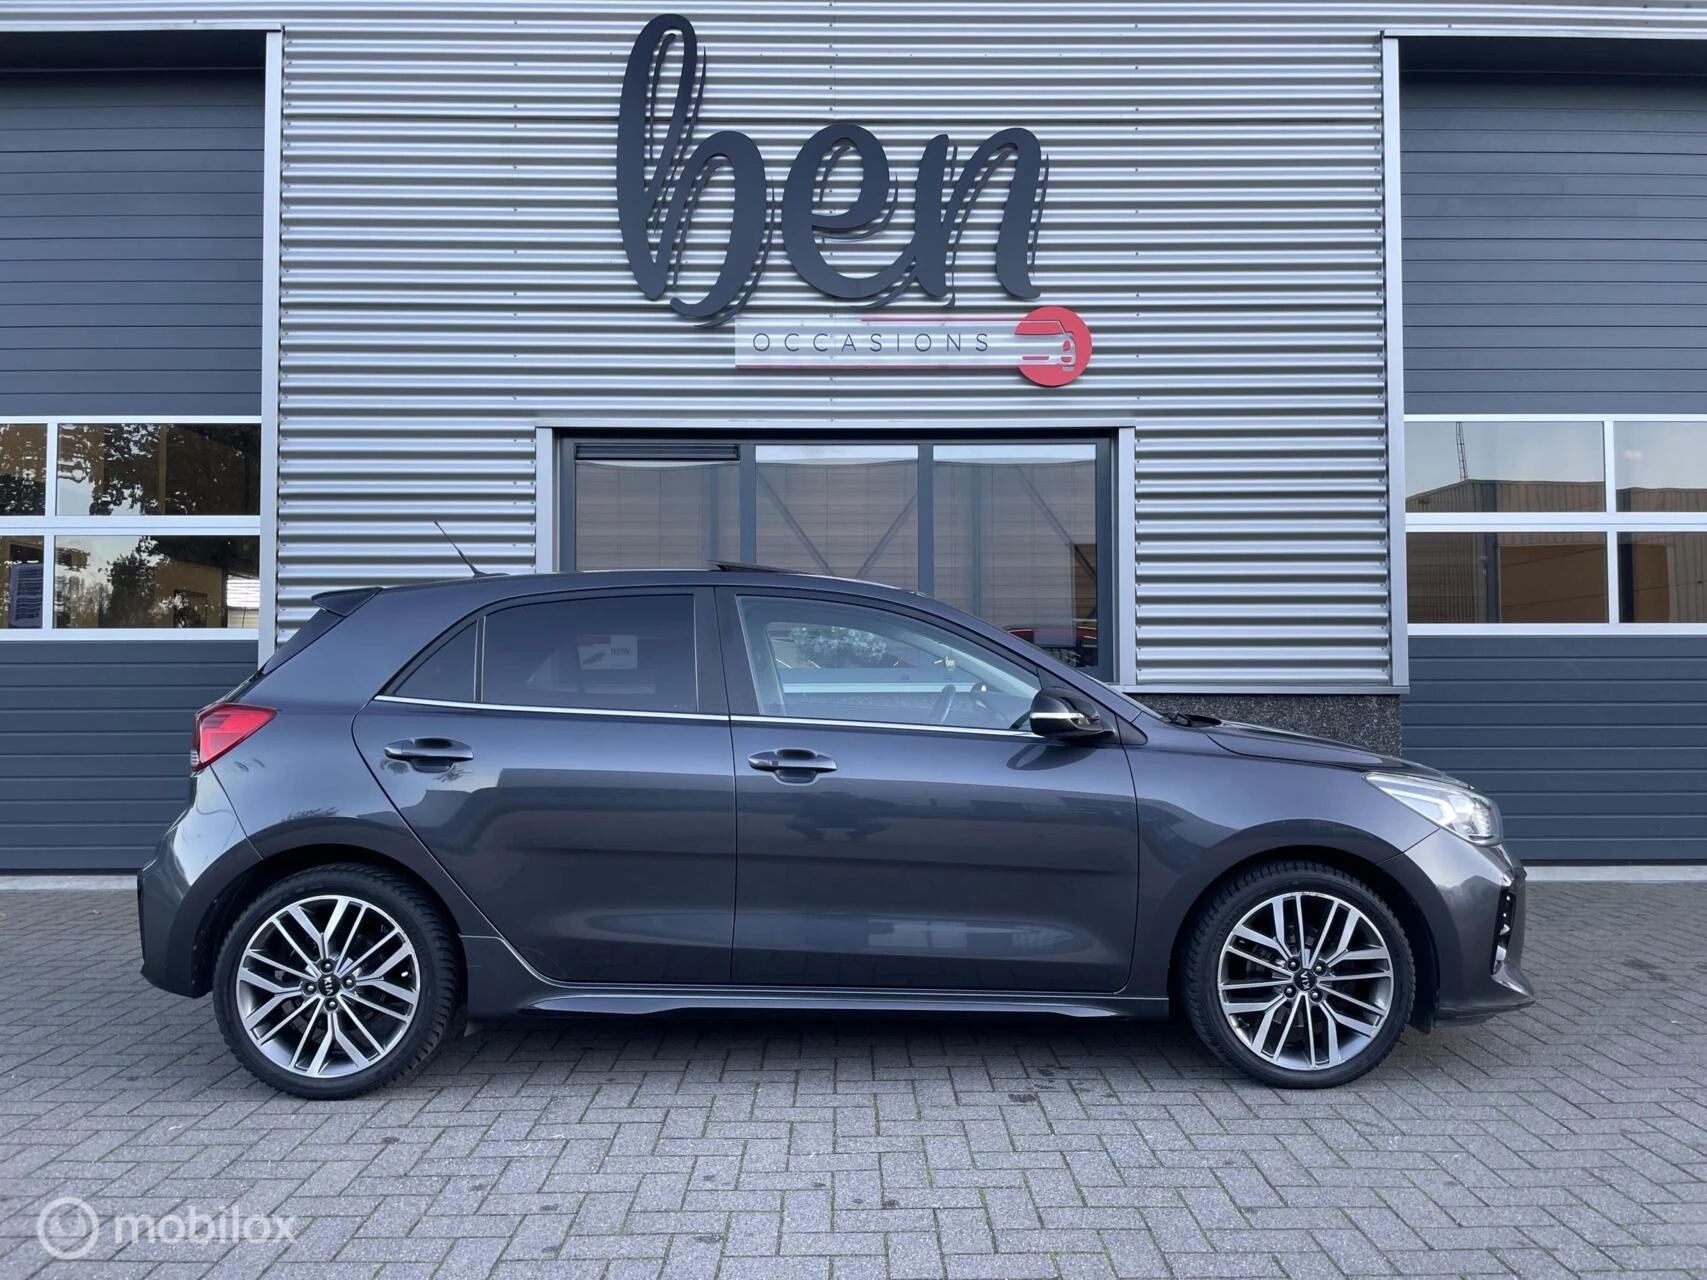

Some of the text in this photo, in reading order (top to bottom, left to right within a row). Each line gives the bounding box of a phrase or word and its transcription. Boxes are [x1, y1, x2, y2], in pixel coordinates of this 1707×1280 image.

[616, 14, 1042, 317] ben
[752, 332, 990, 353] OCCASIONS
[323, 976, 334, 995] KIA
[1300, 971, 1310, 989] KIA
